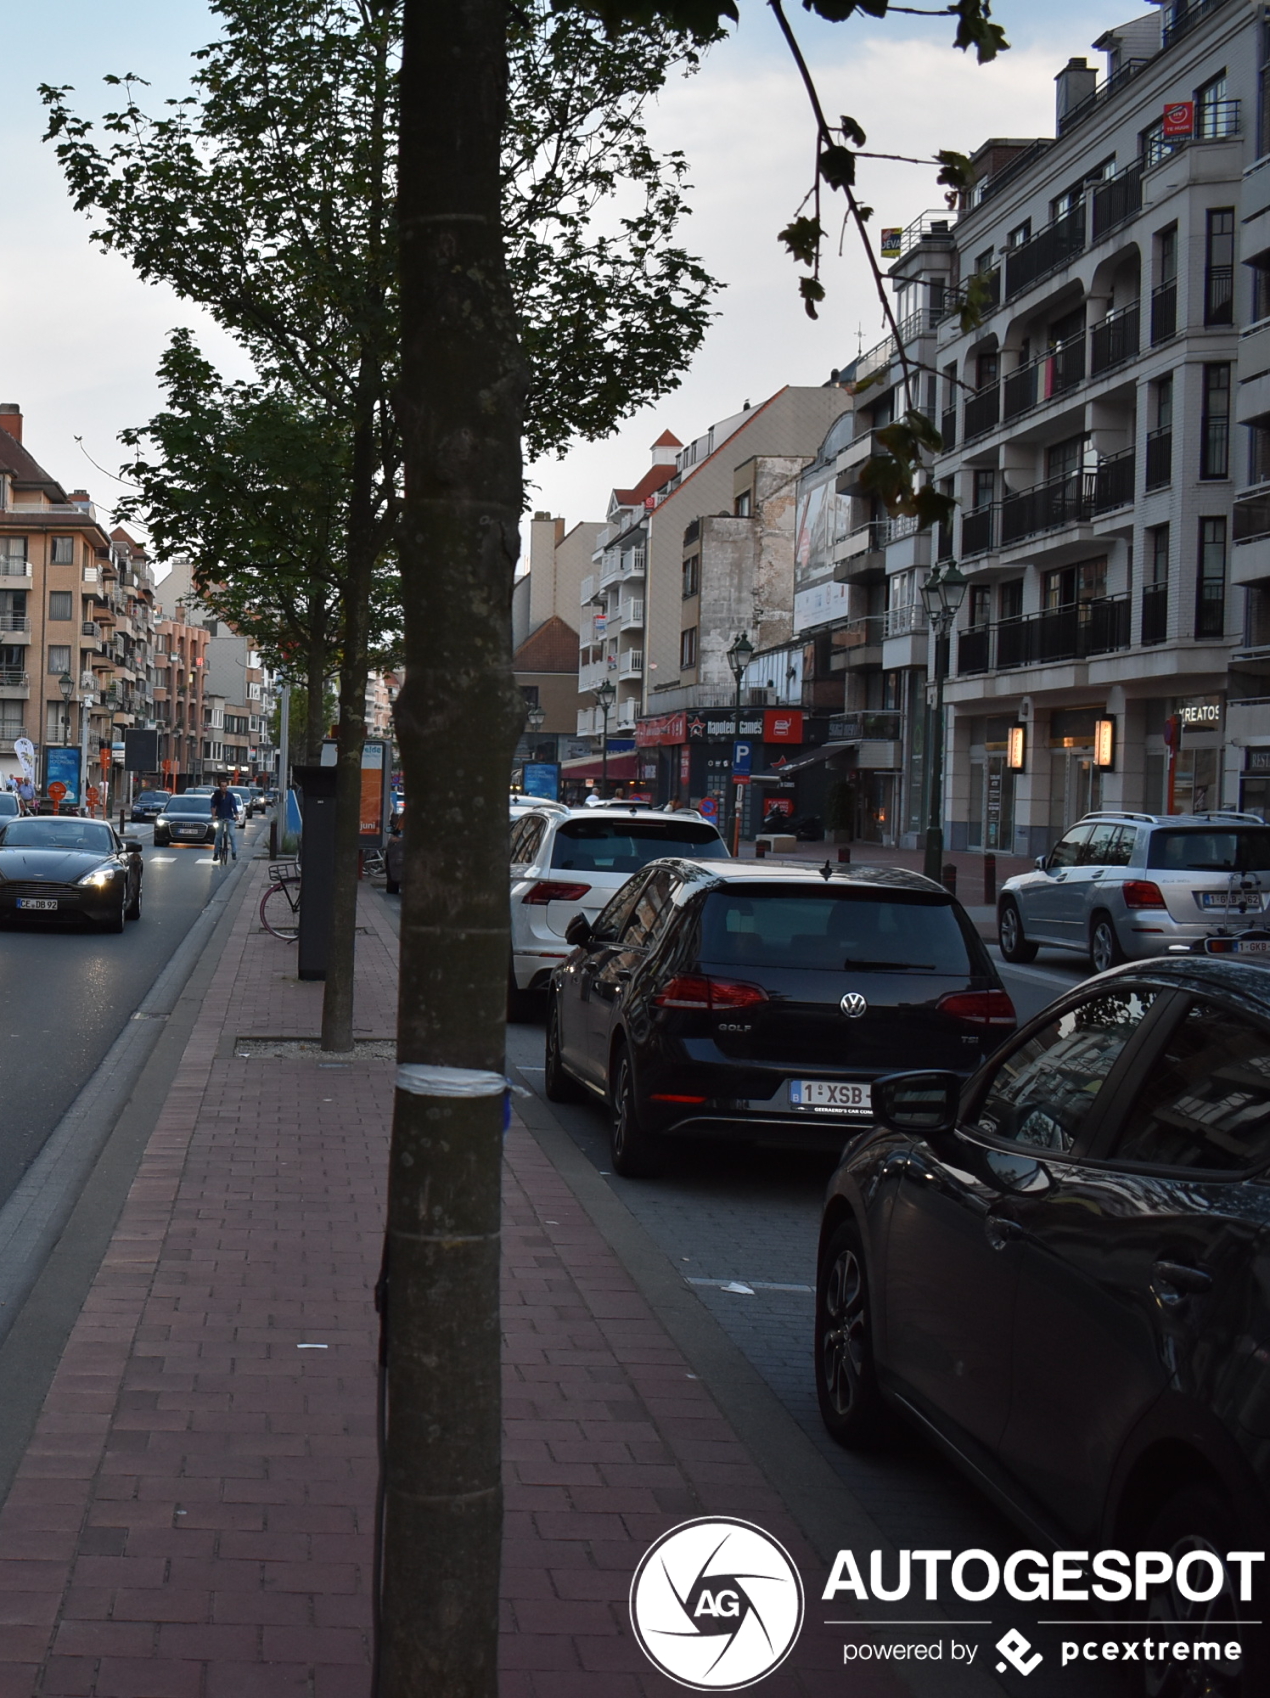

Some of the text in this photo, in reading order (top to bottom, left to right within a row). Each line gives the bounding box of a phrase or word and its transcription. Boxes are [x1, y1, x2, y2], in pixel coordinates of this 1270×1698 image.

[739, 720, 763, 735] Games
[736, 745, 749, 763] P
[1252, 753, 1270, 768] REST
[20, 899, 57, 909] CE DB 92
[718, 1023, 752, 1032] GOLF
[961, 1036, 979, 1044] TSI
